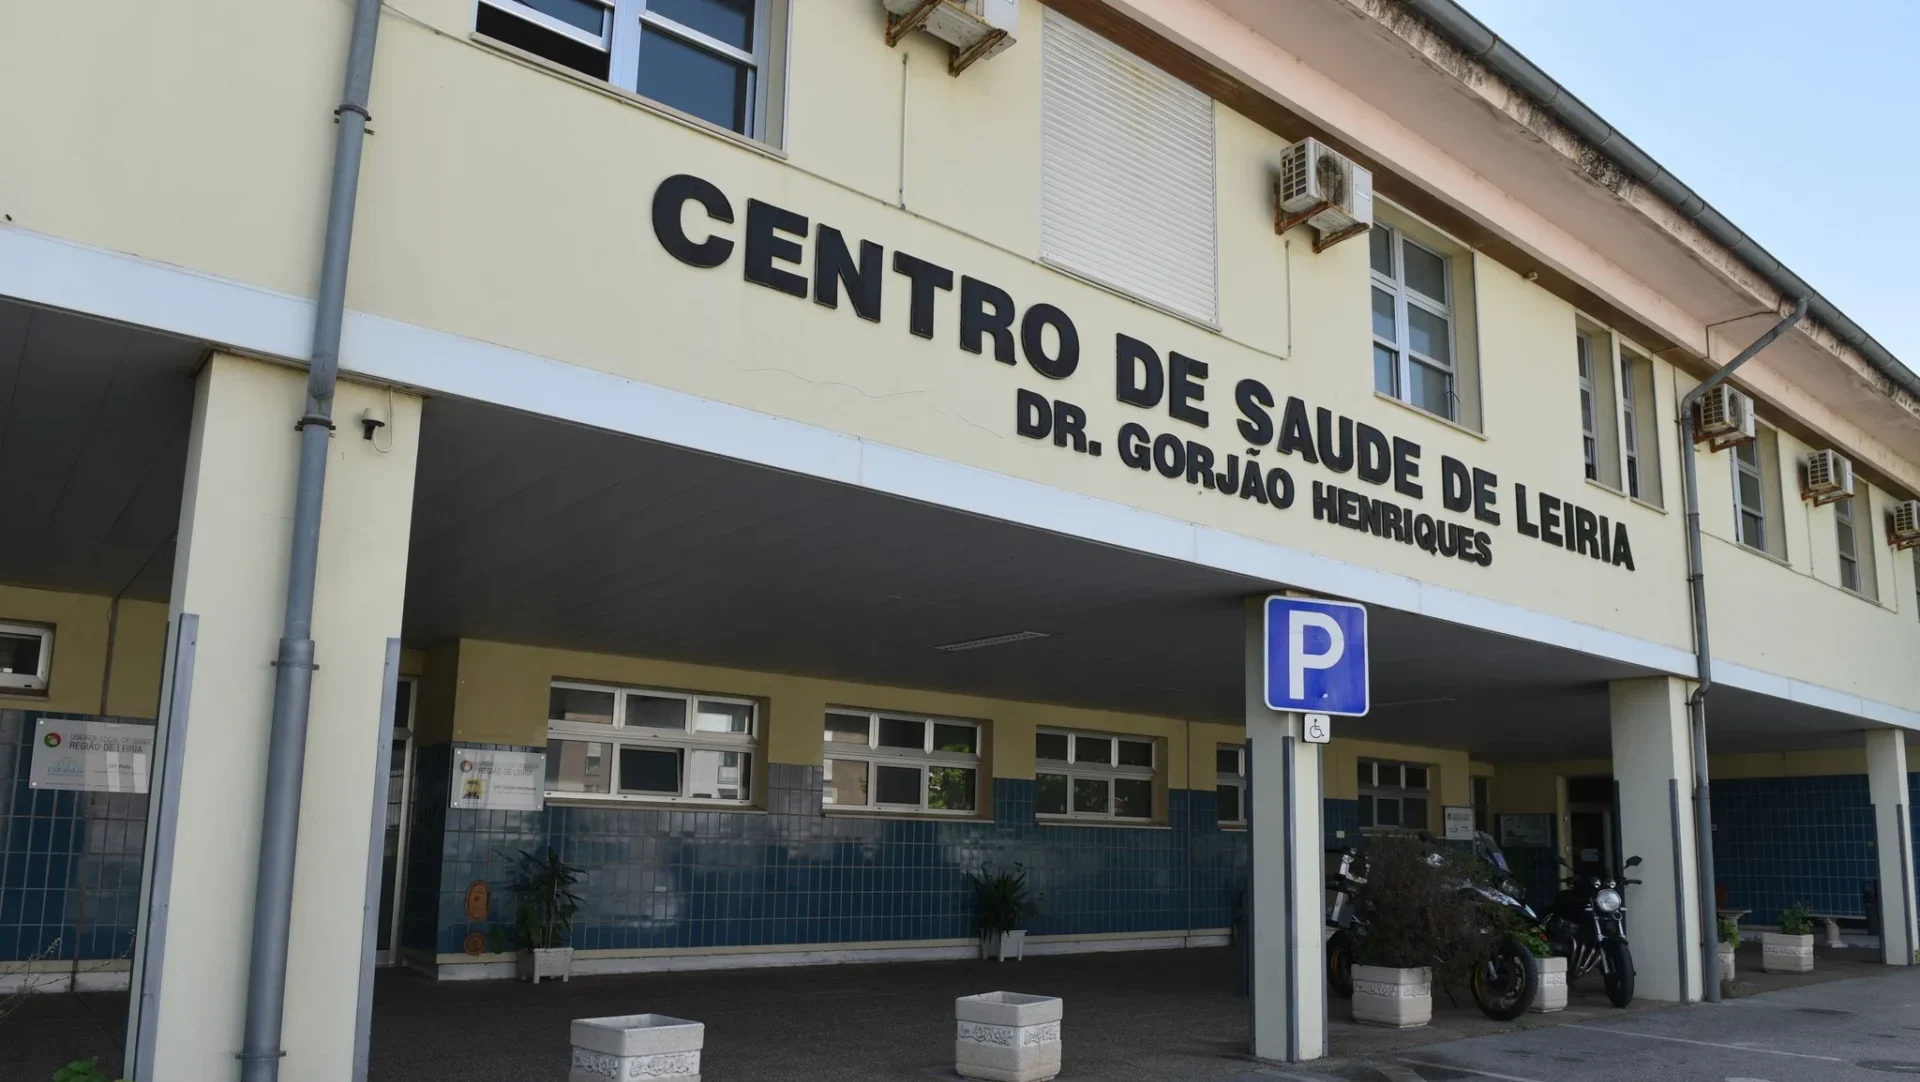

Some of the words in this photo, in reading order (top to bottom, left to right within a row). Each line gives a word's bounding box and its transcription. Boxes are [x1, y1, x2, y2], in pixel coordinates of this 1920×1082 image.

[652, 173, 1080, 381] CENTRO
[1115, 332, 1210, 428] DE
[1234, 378, 1424, 500] SAUDE
[1441, 455, 1501, 526] DE
[1515, 482, 1636, 572] LEIRIA
[1017, 387, 1102, 457] DR.
[1117, 422, 1295, 510] GORJÃO
[1312, 480, 1493, 568] HENRIQUES
[1288, 609, 1345, 700] P
[69, 740, 100, 750] REGIÃO
[103, 743, 115, 752] DE
[116, 744, 143, 754] LEIRIA
